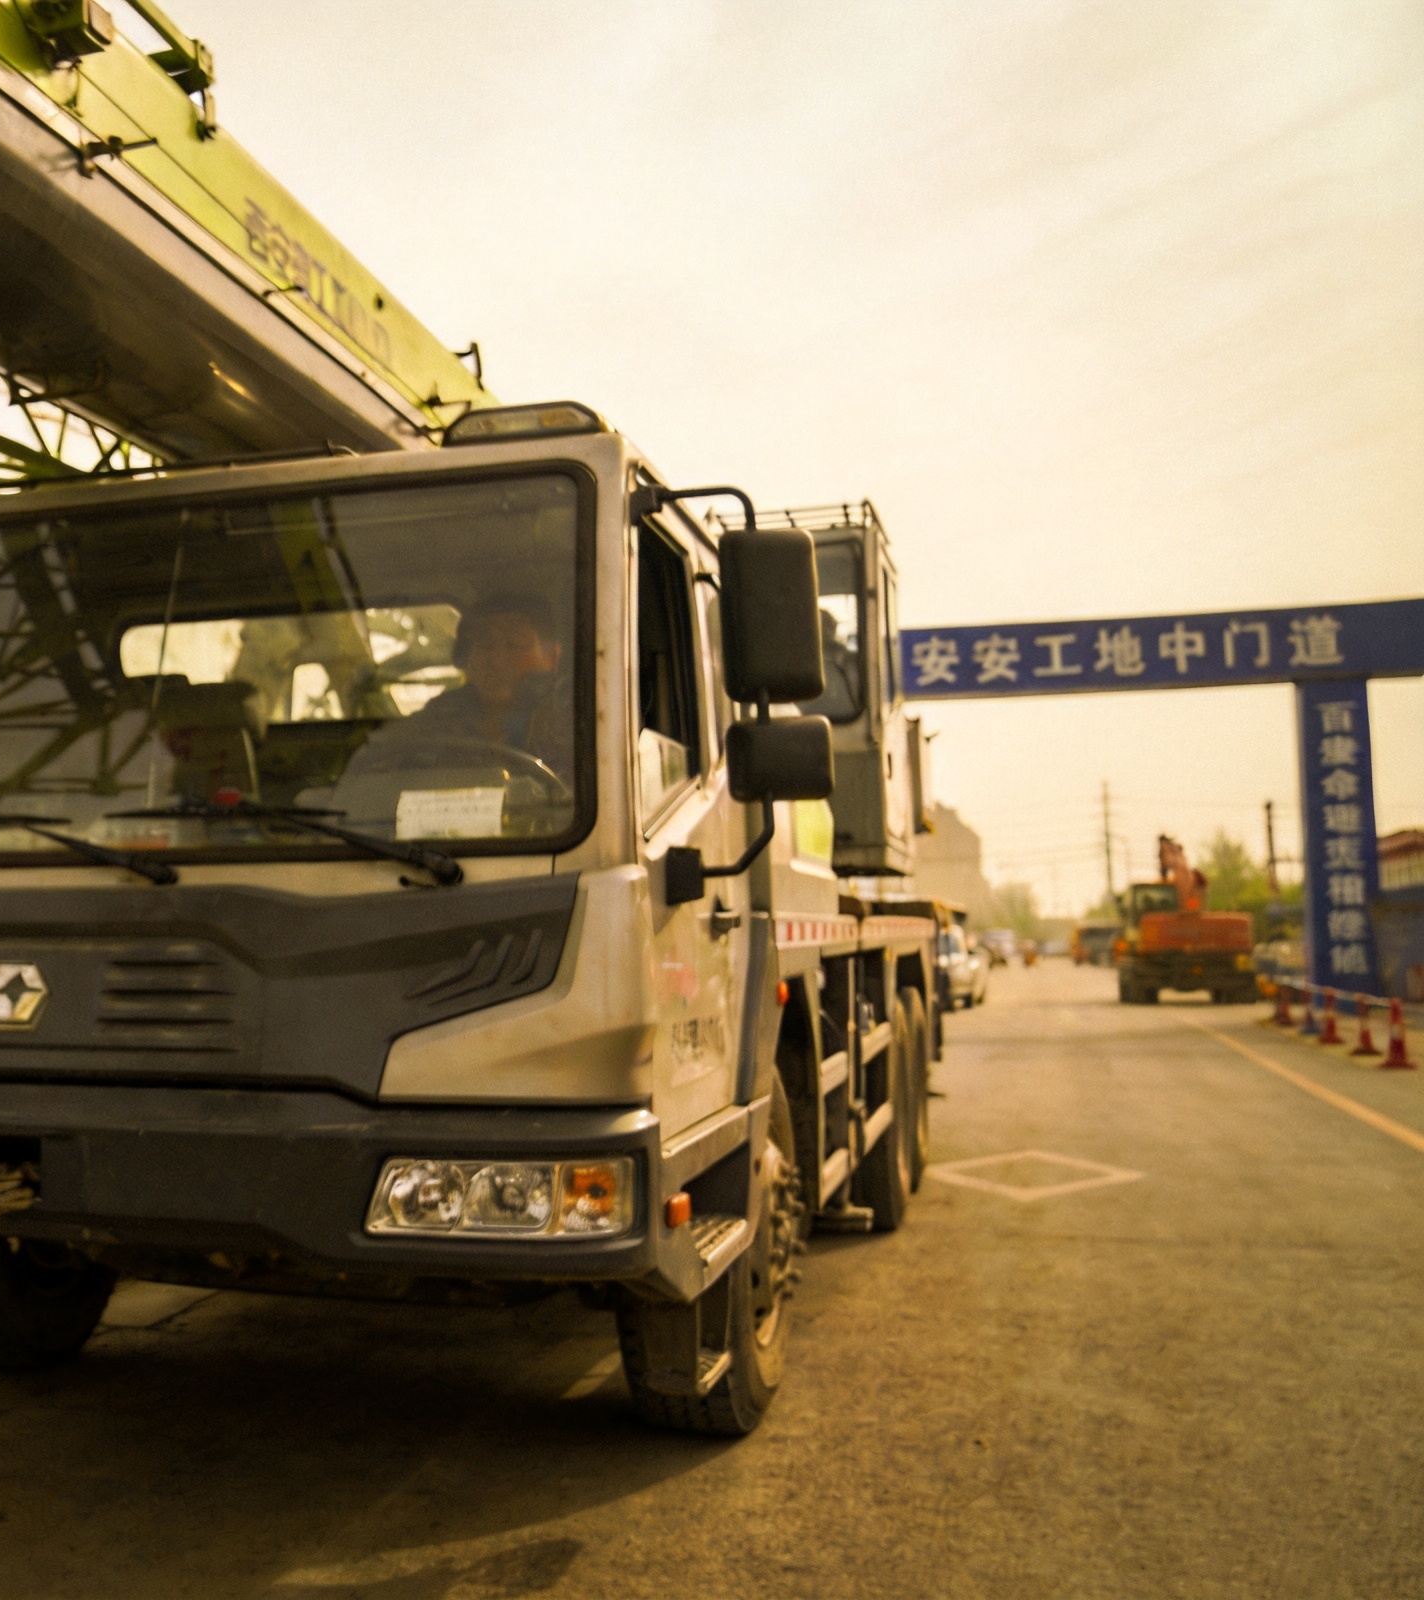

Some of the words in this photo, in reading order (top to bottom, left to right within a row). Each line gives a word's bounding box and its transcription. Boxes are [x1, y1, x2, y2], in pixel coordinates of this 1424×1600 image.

[911, 613, 1345, 687] 安安工地中门道
